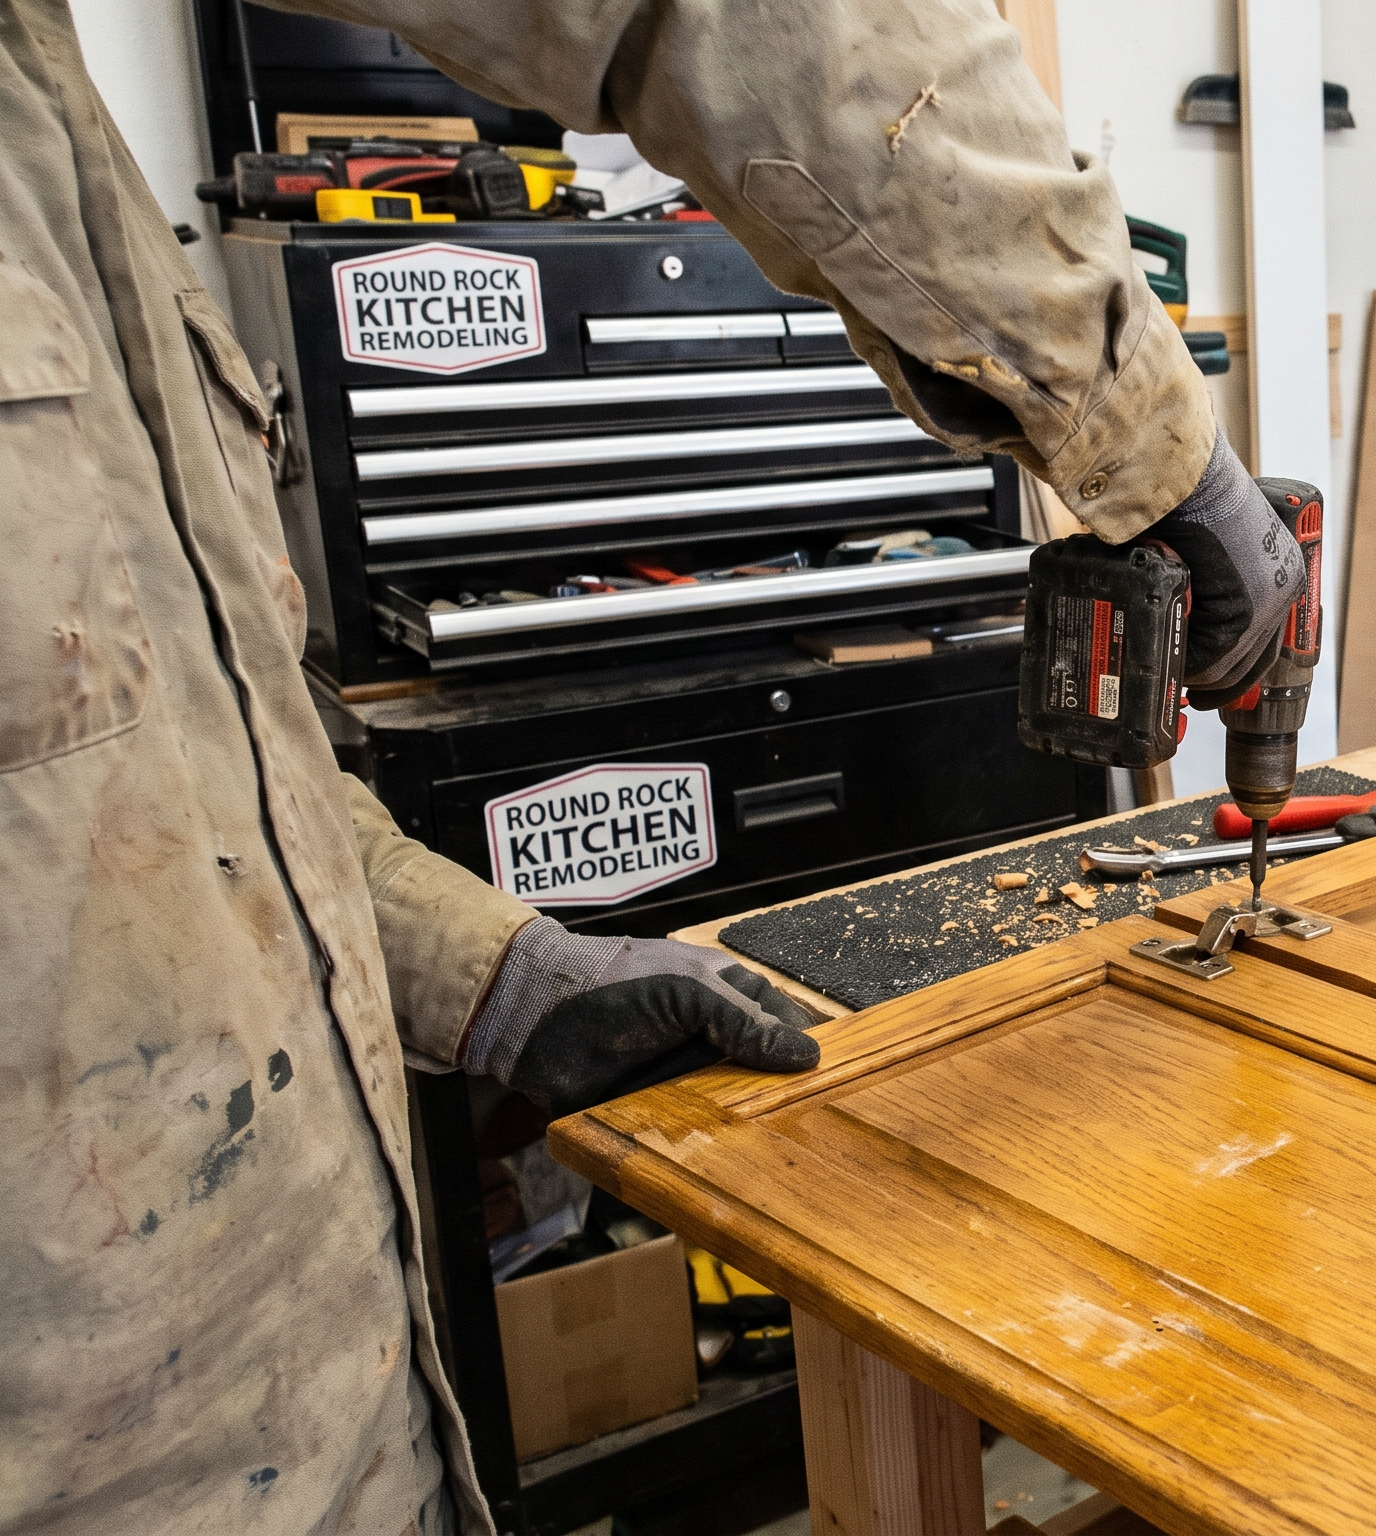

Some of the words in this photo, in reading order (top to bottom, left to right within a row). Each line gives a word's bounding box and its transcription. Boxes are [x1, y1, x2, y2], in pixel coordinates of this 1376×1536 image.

[352, 270, 446, 294] ROUND
[453, 268, 522, 291] ROCK
[355, 294, 526, 327] KITCHEN
[359, 326, 529, 351] REMODELING
[506, 791, 611, 831] ROUND
[617, 776, 693, 811] ROCK
[509, 804, 698, 869] KITCHEN
[513, 839, 700, 895] REMODELING
